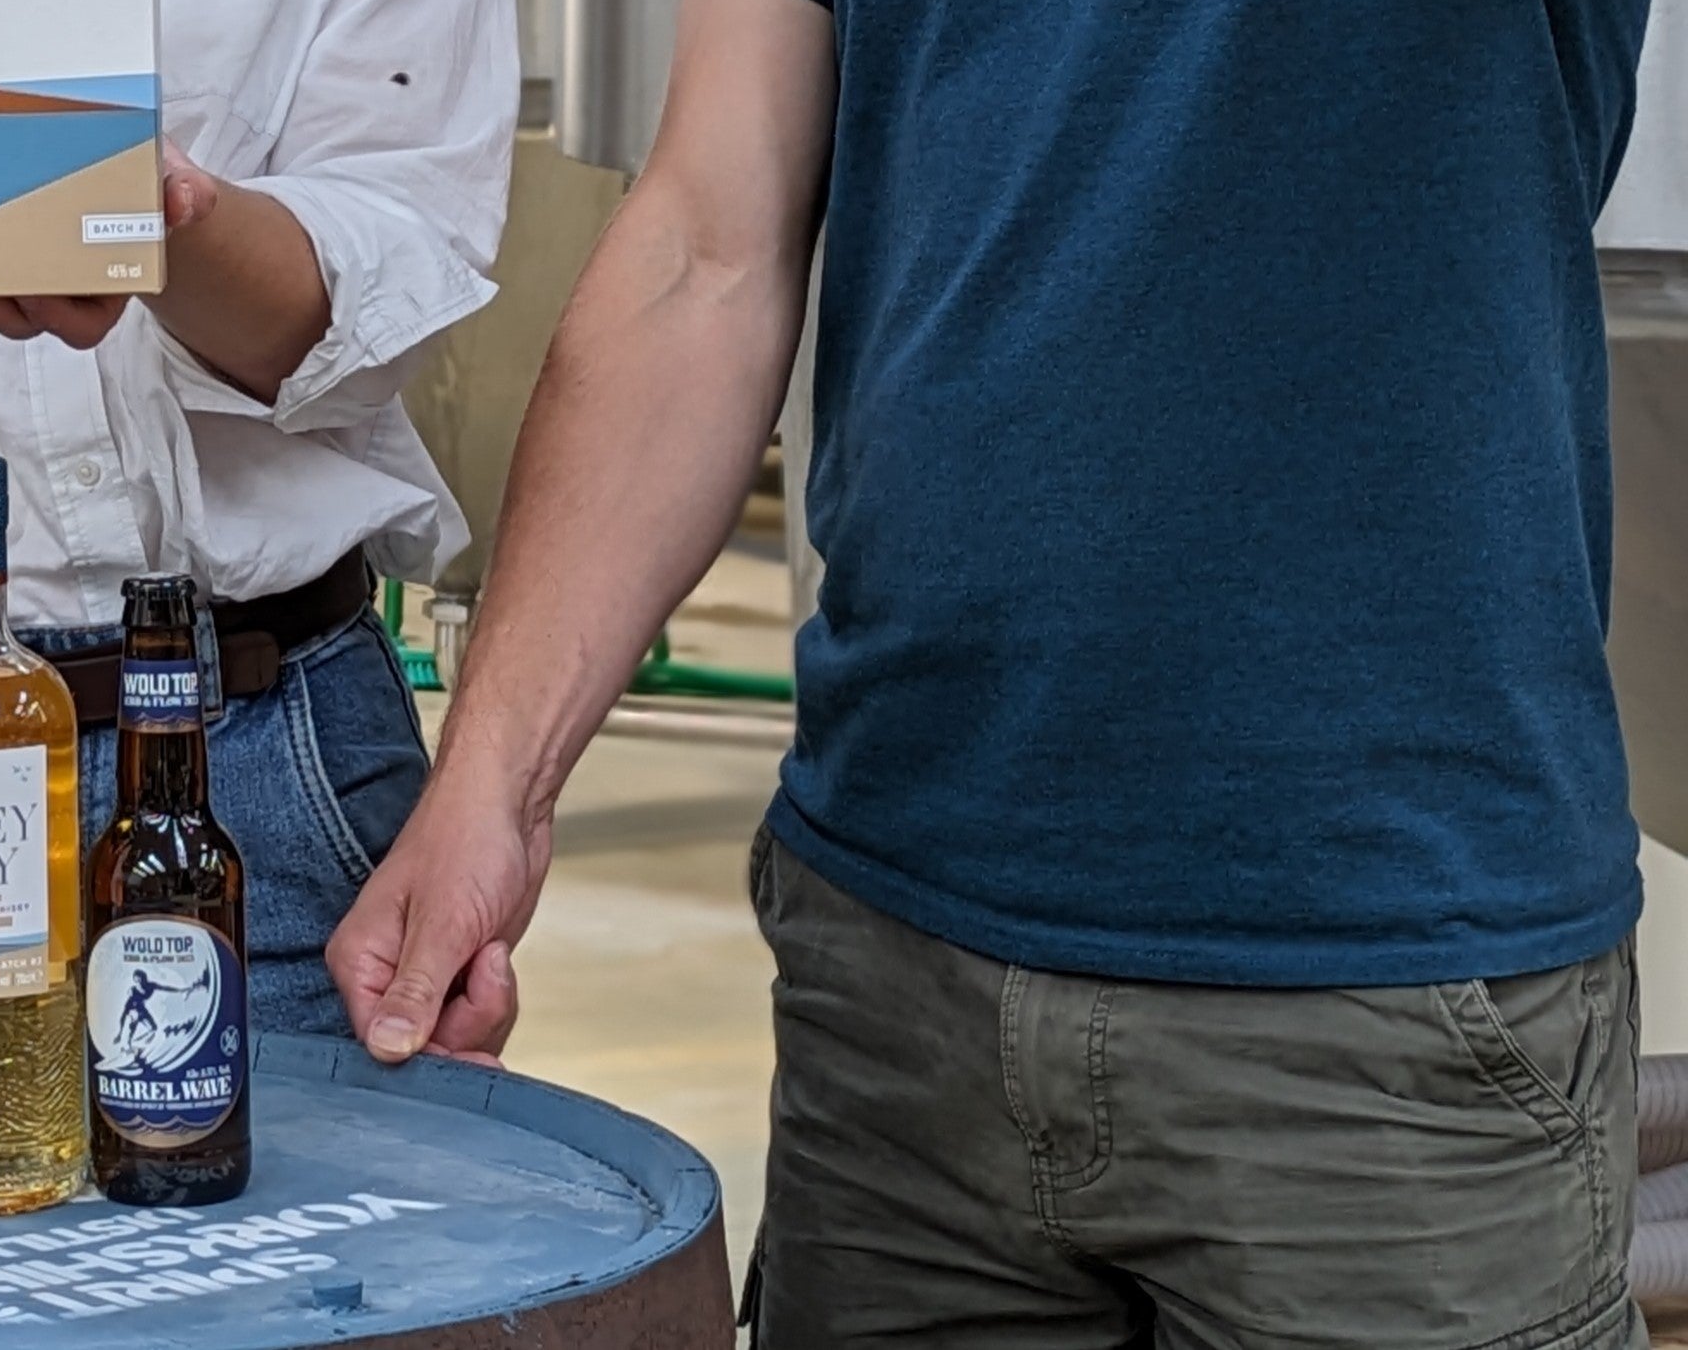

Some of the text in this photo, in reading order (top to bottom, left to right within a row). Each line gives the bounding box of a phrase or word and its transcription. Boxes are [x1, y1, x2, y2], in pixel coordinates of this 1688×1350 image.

[93, 223, 155, 234] BATCH #2
[124, 672, 170, 695] WOLD
[122, 935, 163, 954] WOLD
[98, 1075, 232, 1101] BARREL WAVE
[29, 1246, 339, 1320] SPIRIT
